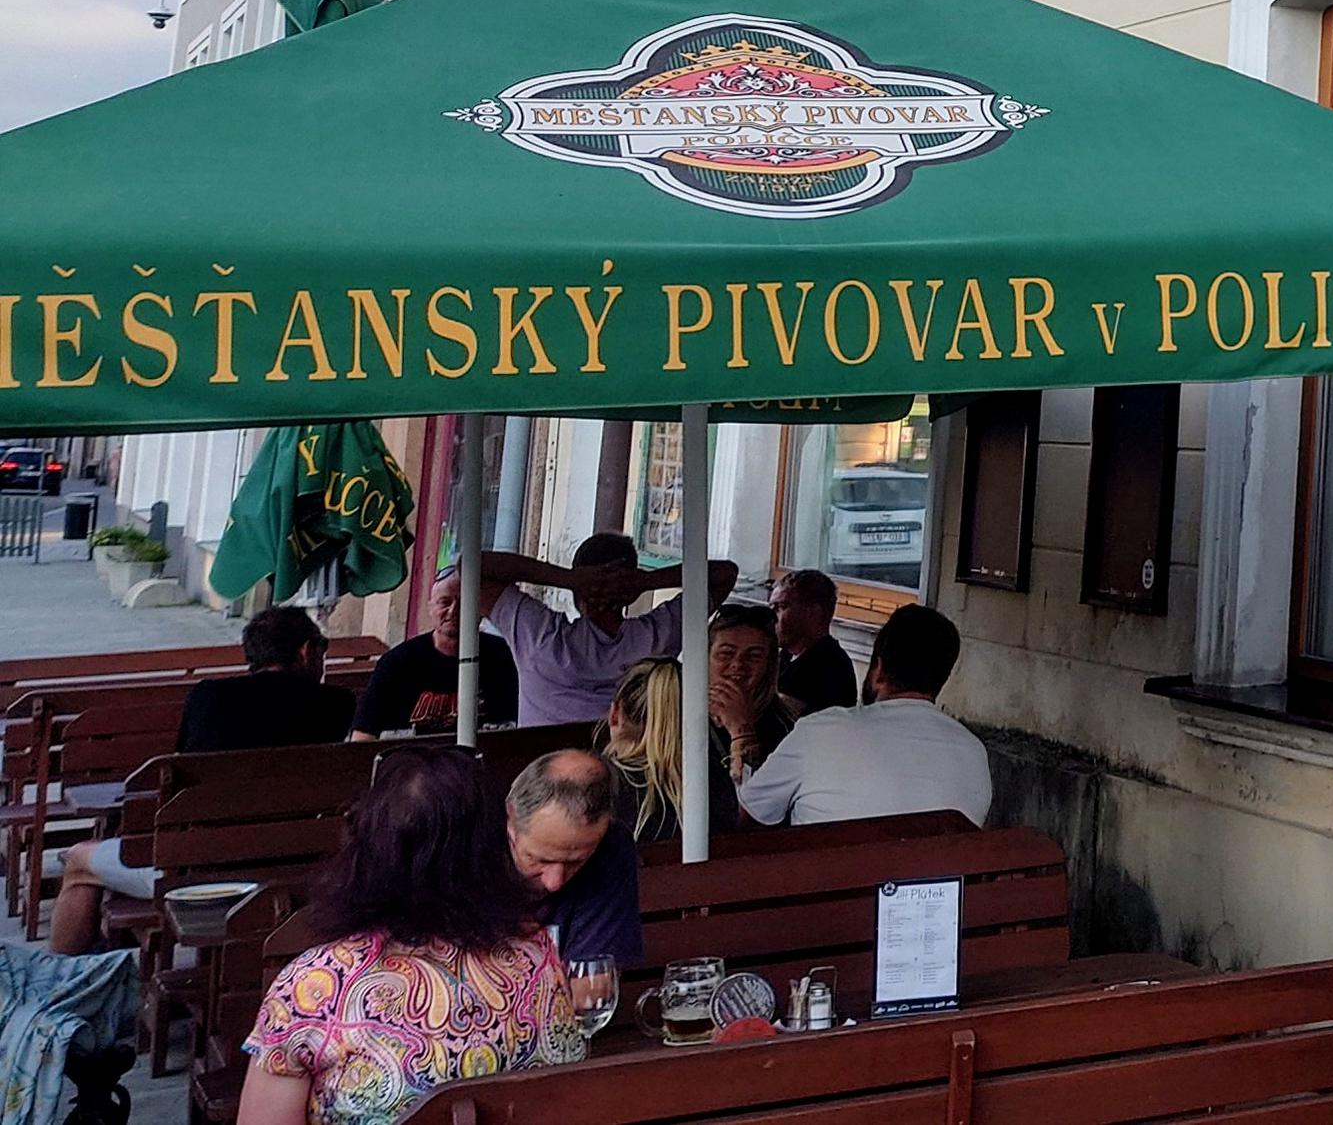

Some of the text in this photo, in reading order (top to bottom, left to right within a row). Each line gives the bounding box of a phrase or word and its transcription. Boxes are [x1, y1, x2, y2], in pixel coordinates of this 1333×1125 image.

[531, 101, 975, 126] MĚŠŤANSKÝ PIVOVAR
[681, 132, 854, 147] POLIČCE
[662, 276, 1065, 371] PIVOVAR
